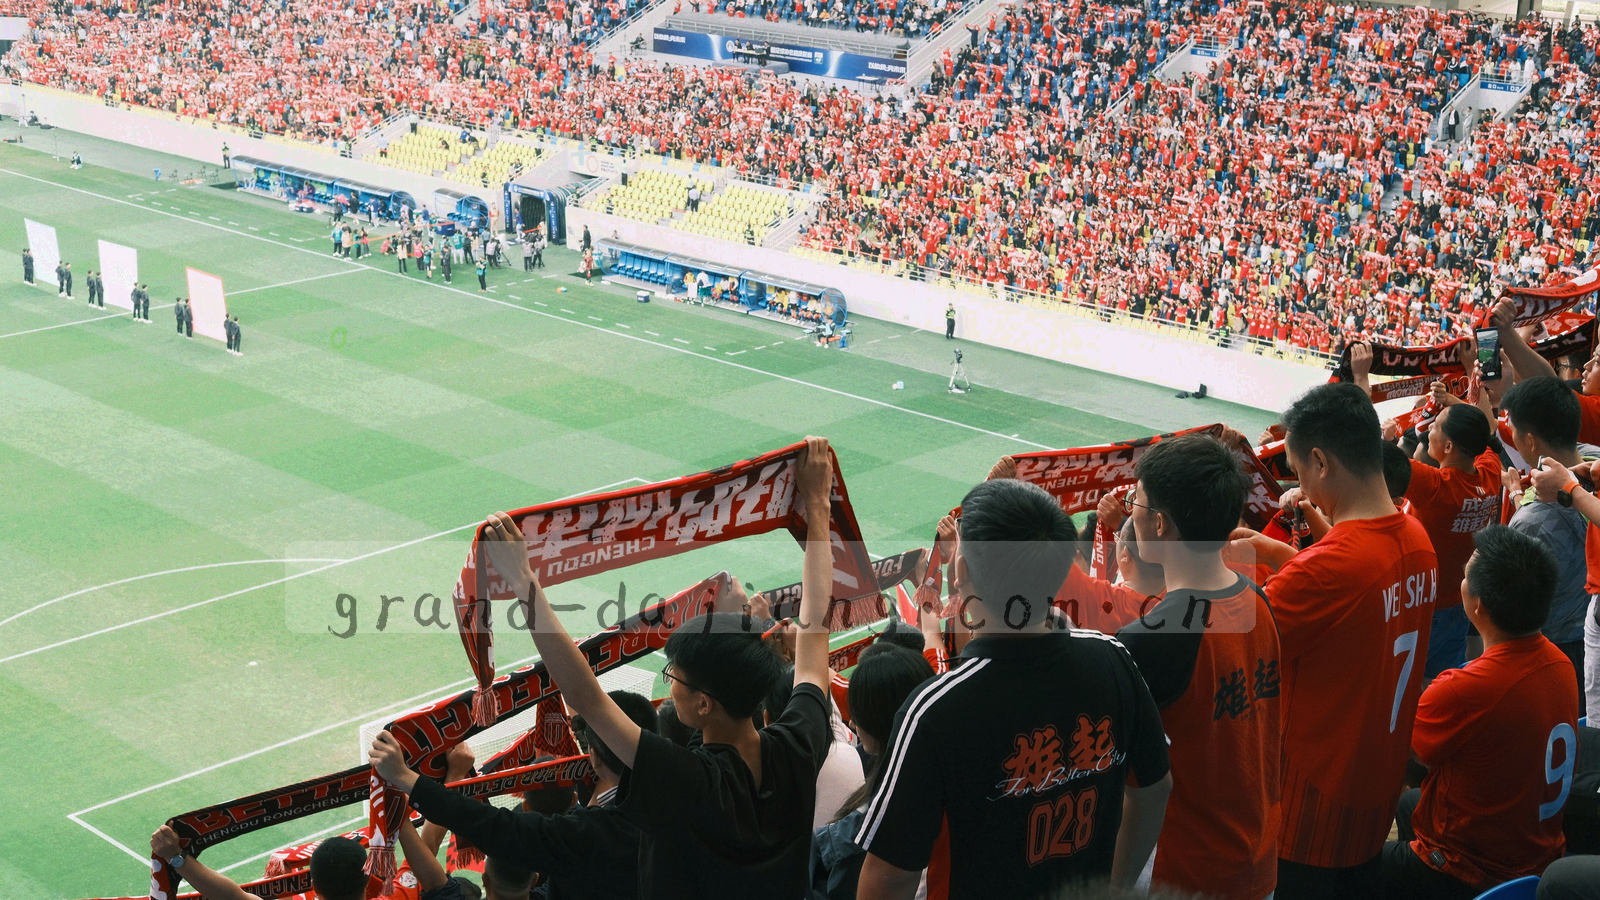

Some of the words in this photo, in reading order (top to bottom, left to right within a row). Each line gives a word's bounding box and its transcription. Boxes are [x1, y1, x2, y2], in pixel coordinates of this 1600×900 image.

[1213, 658, 1281, 722] 雄起
[1390, 630, 1418, 734] 7
[1002, 712, 1117, 793] 雄起
[1539, 723, 1577, 822] 9
[194, 819, 261, 846] CHENGDU
[263, 792, 351, 824] RONGCHENG
[1026, 786, 1099, 867] 028
